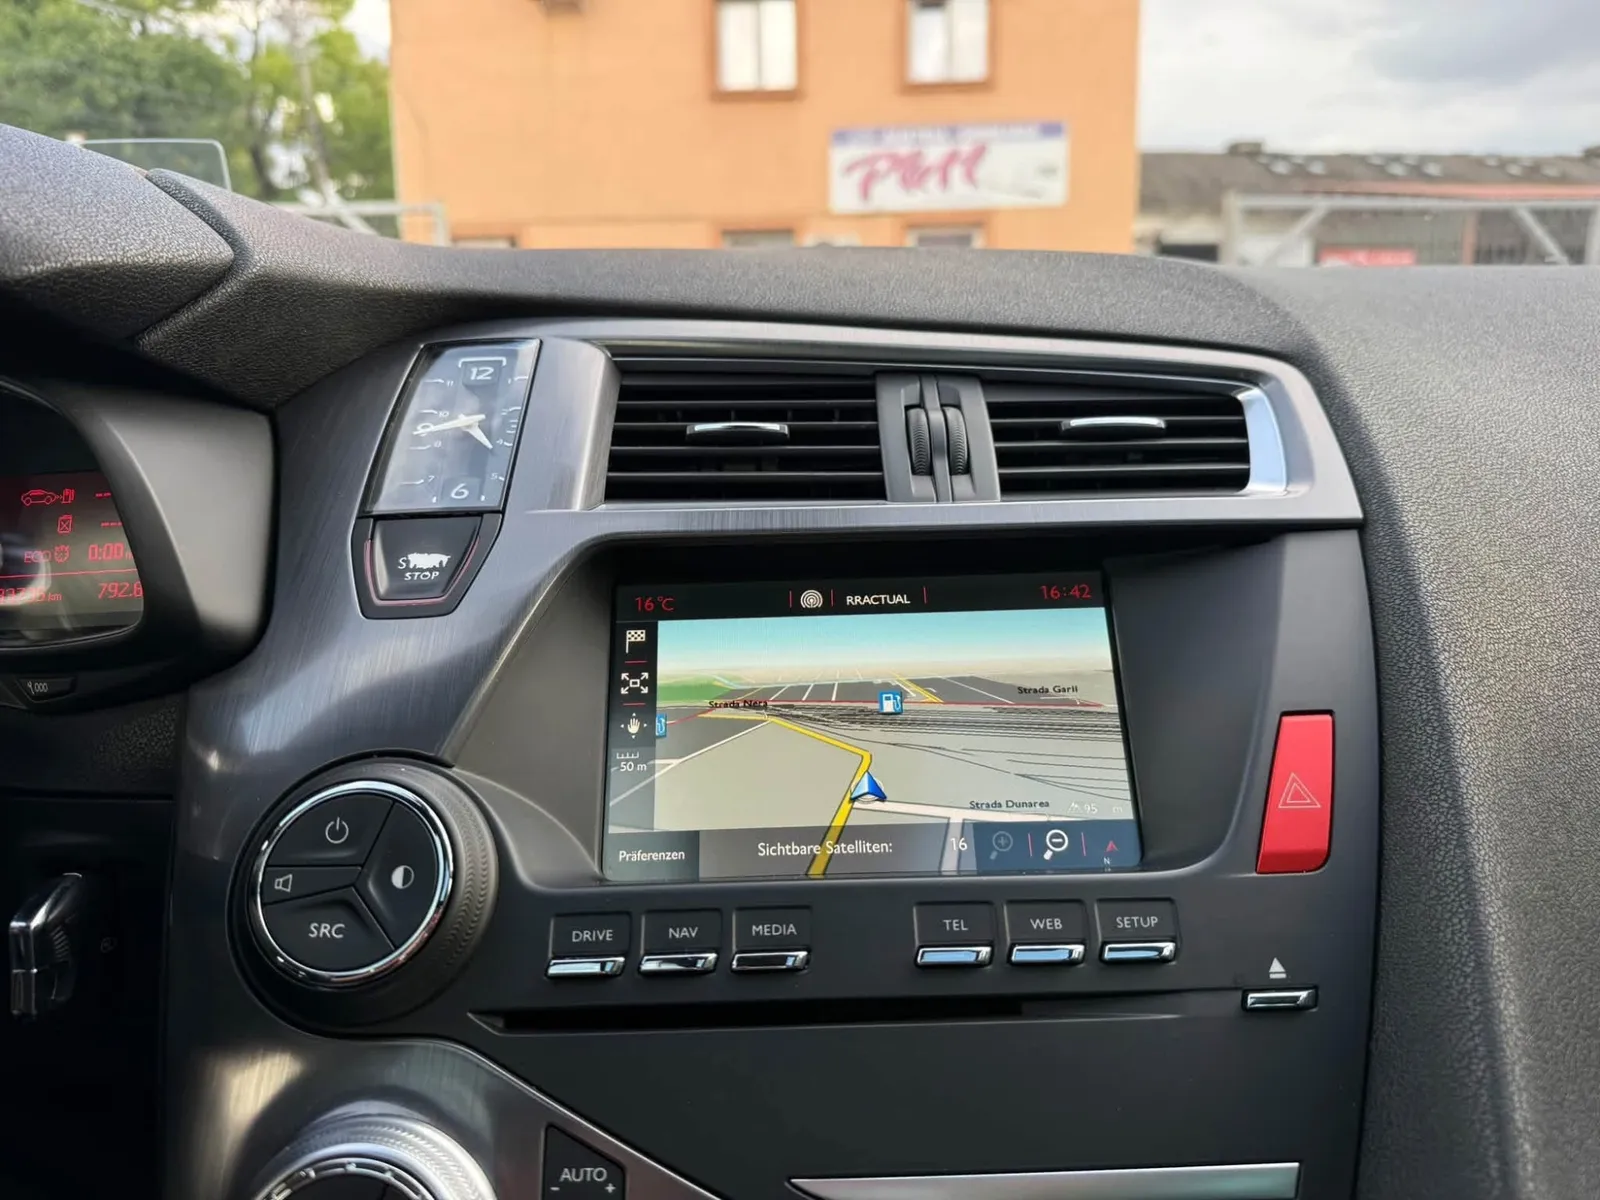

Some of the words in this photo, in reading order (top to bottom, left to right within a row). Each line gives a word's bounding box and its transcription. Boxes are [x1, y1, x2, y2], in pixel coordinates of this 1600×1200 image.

[470, 366, 494, 381] 12
[428, 475, 435, 483] 7
[450, 483, 469, 500] 6
[88, 542, 124, 561] 0:00
[404, 571, 439, 581] STOP
[1041, 584, 1092, 600] 16:42
[846, 593, 910, 606] RRACTUAL
[1017, 685, 1050, 694] Strada
[708, 700, 740, 709] Strada
[743, 699, 768, 708] Nera
[620, 761, 634, 772] 50
[637, 763, 647, 771] m
[969, 800, 1003, 809] Strada
[1005, 799, 1050, 808] Dunarea
[1084, 803, 1099, 814] 95
[757, 843, 821, 857] Sichtbare
[825, 838, 893, 855] Satelliten:
[950, 837, 968, 851] 16
[618, 849, 686, 863] Präferenzen
[1103, 856, 1110, 865] N
[943, 919, 969, 931] TEL
[1030, 918, 1063, 930] WEB
[1115, 916, 1159, 929] SETUP
[308, 923, 345, 938] SRC
[571, 928, 614, 942] DRIVE
[668, 926, 699, 939] NAV
[751, 923, 798, 936] MEDIA
[559, 1167, 607, 1182] AUTO
